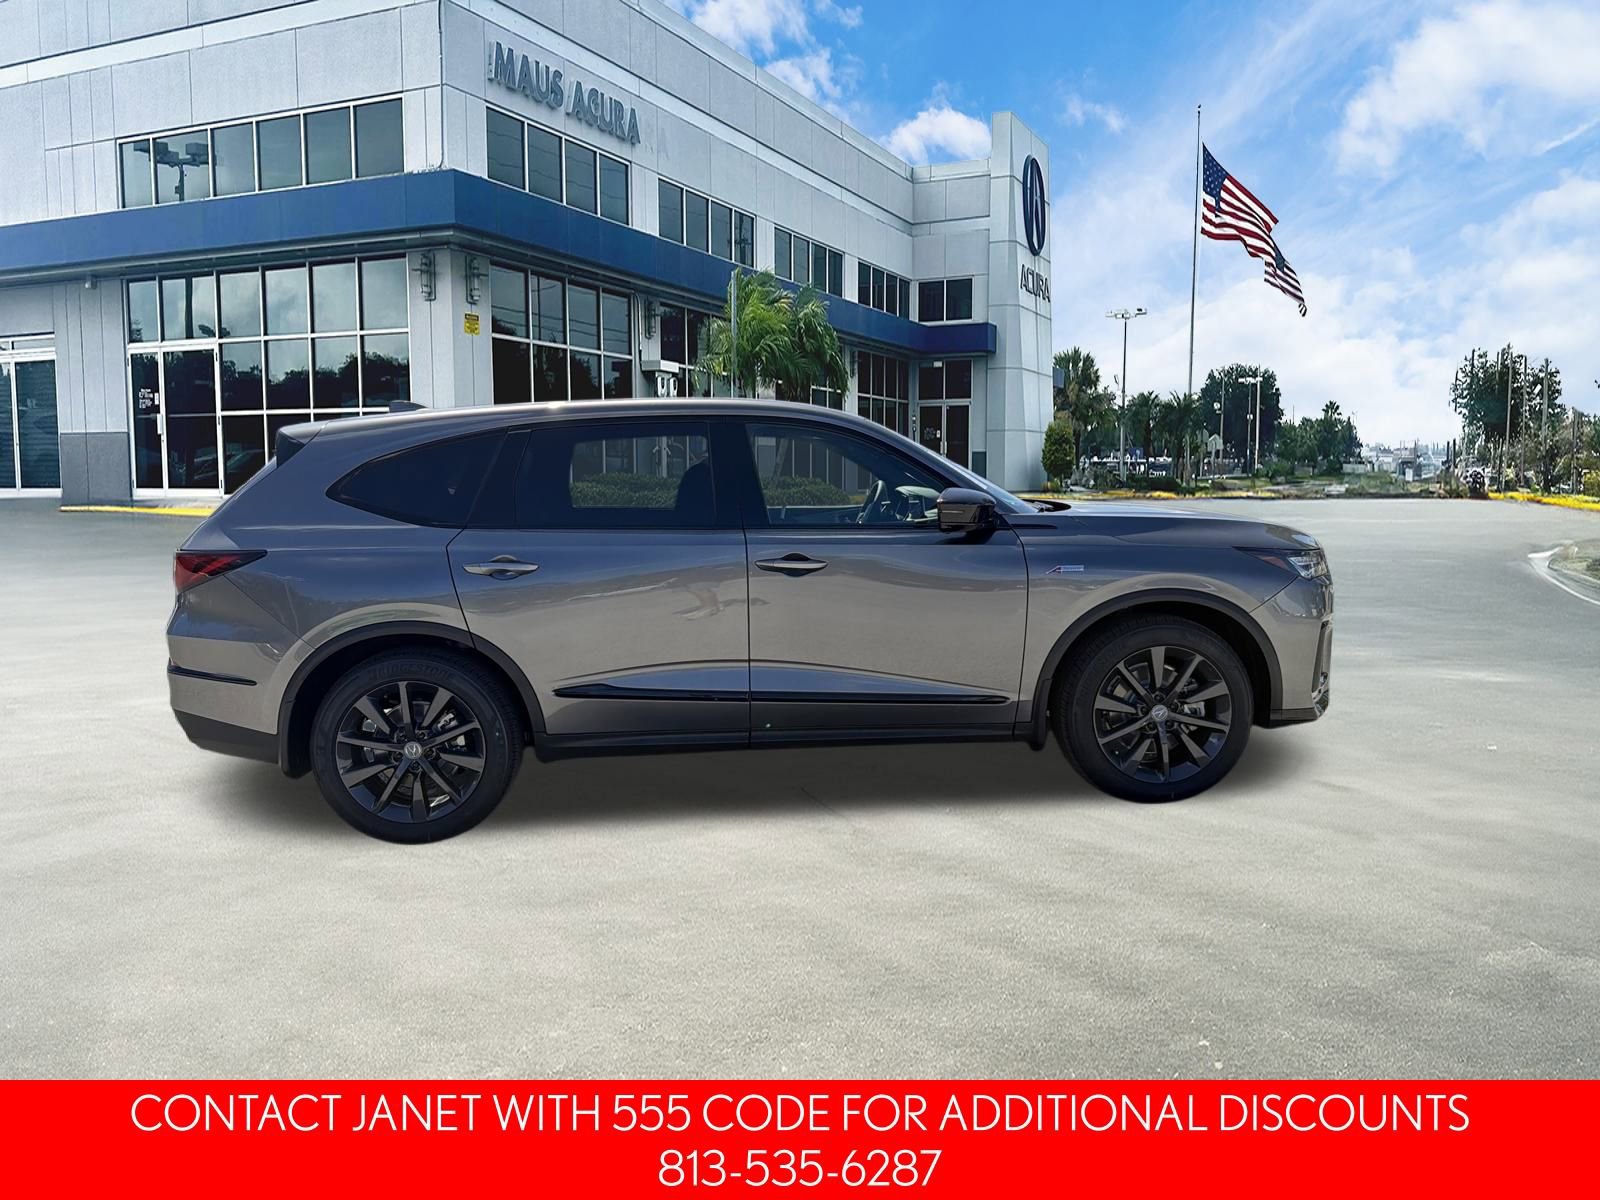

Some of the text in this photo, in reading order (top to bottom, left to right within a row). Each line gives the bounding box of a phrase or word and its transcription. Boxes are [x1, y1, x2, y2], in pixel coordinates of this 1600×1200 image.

[488, 41, 641, 144] MAUS ACURA
[1020, 264, 1051, 302] ACURA
